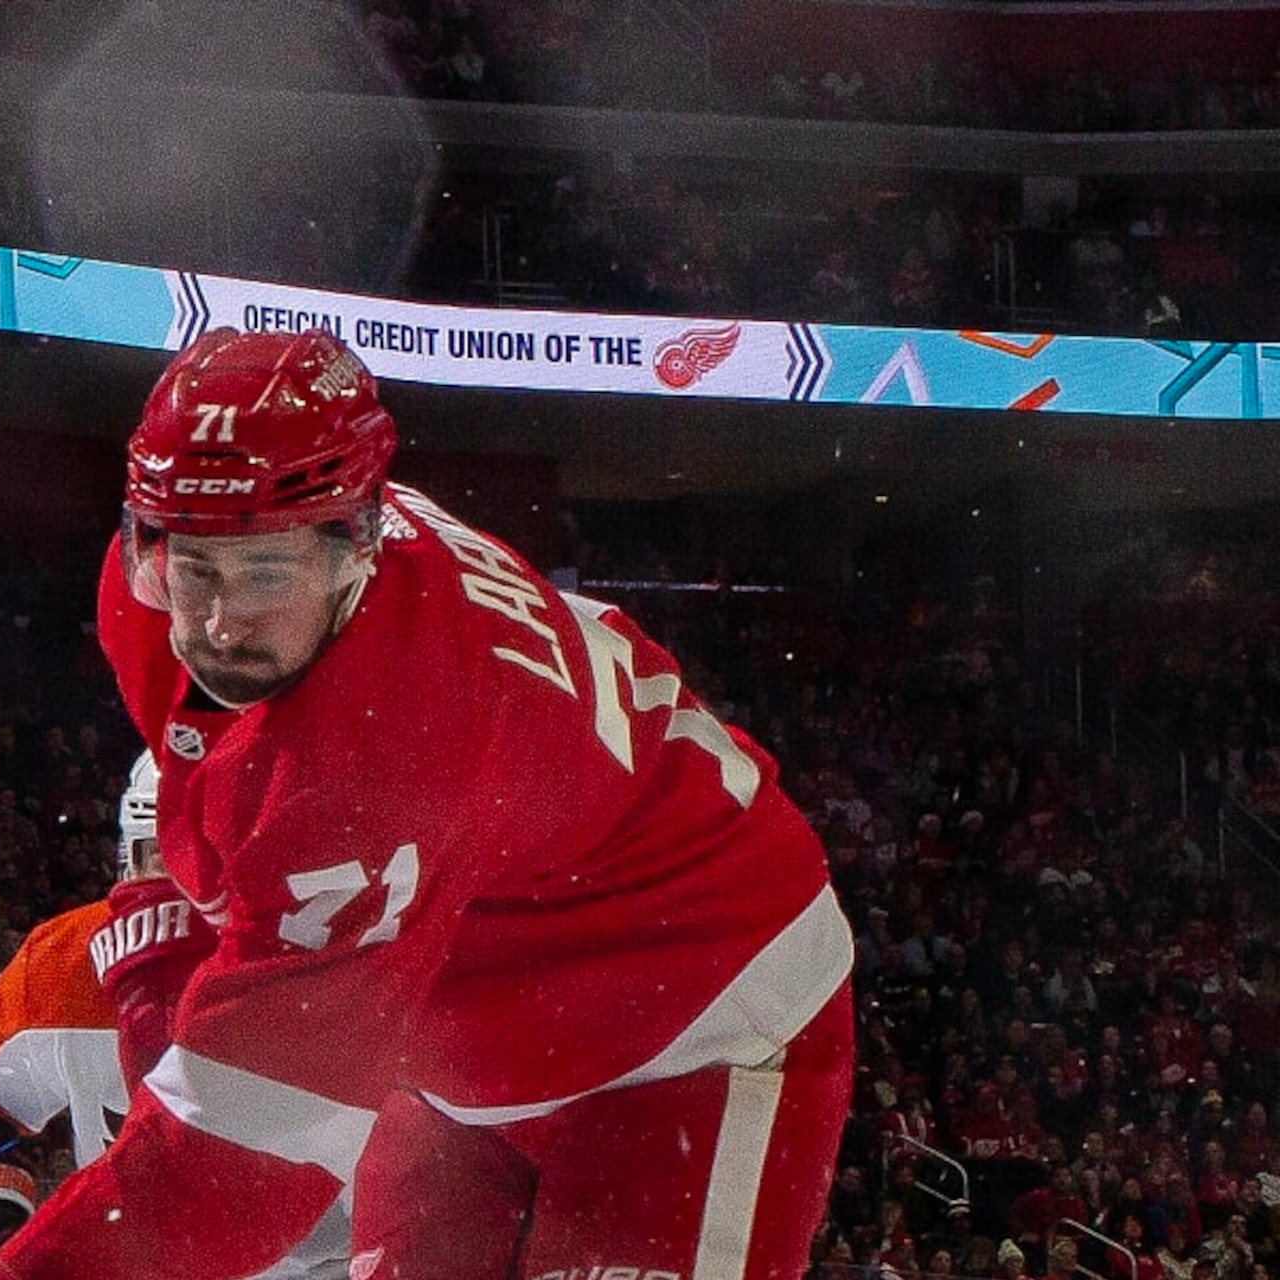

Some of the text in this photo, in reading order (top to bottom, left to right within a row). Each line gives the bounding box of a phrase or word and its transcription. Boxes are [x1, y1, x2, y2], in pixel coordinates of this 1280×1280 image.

[355, 318, 439, 356] CREDIT
[447, 328, 535, 361] UNION
[543, 334, 581, 363] OF
[589, 336, 642, 366] THE
[190, 403, 239, 443] 71
[174, 478, 256, 495] CCM
[278, 842, 420, 951] 71
